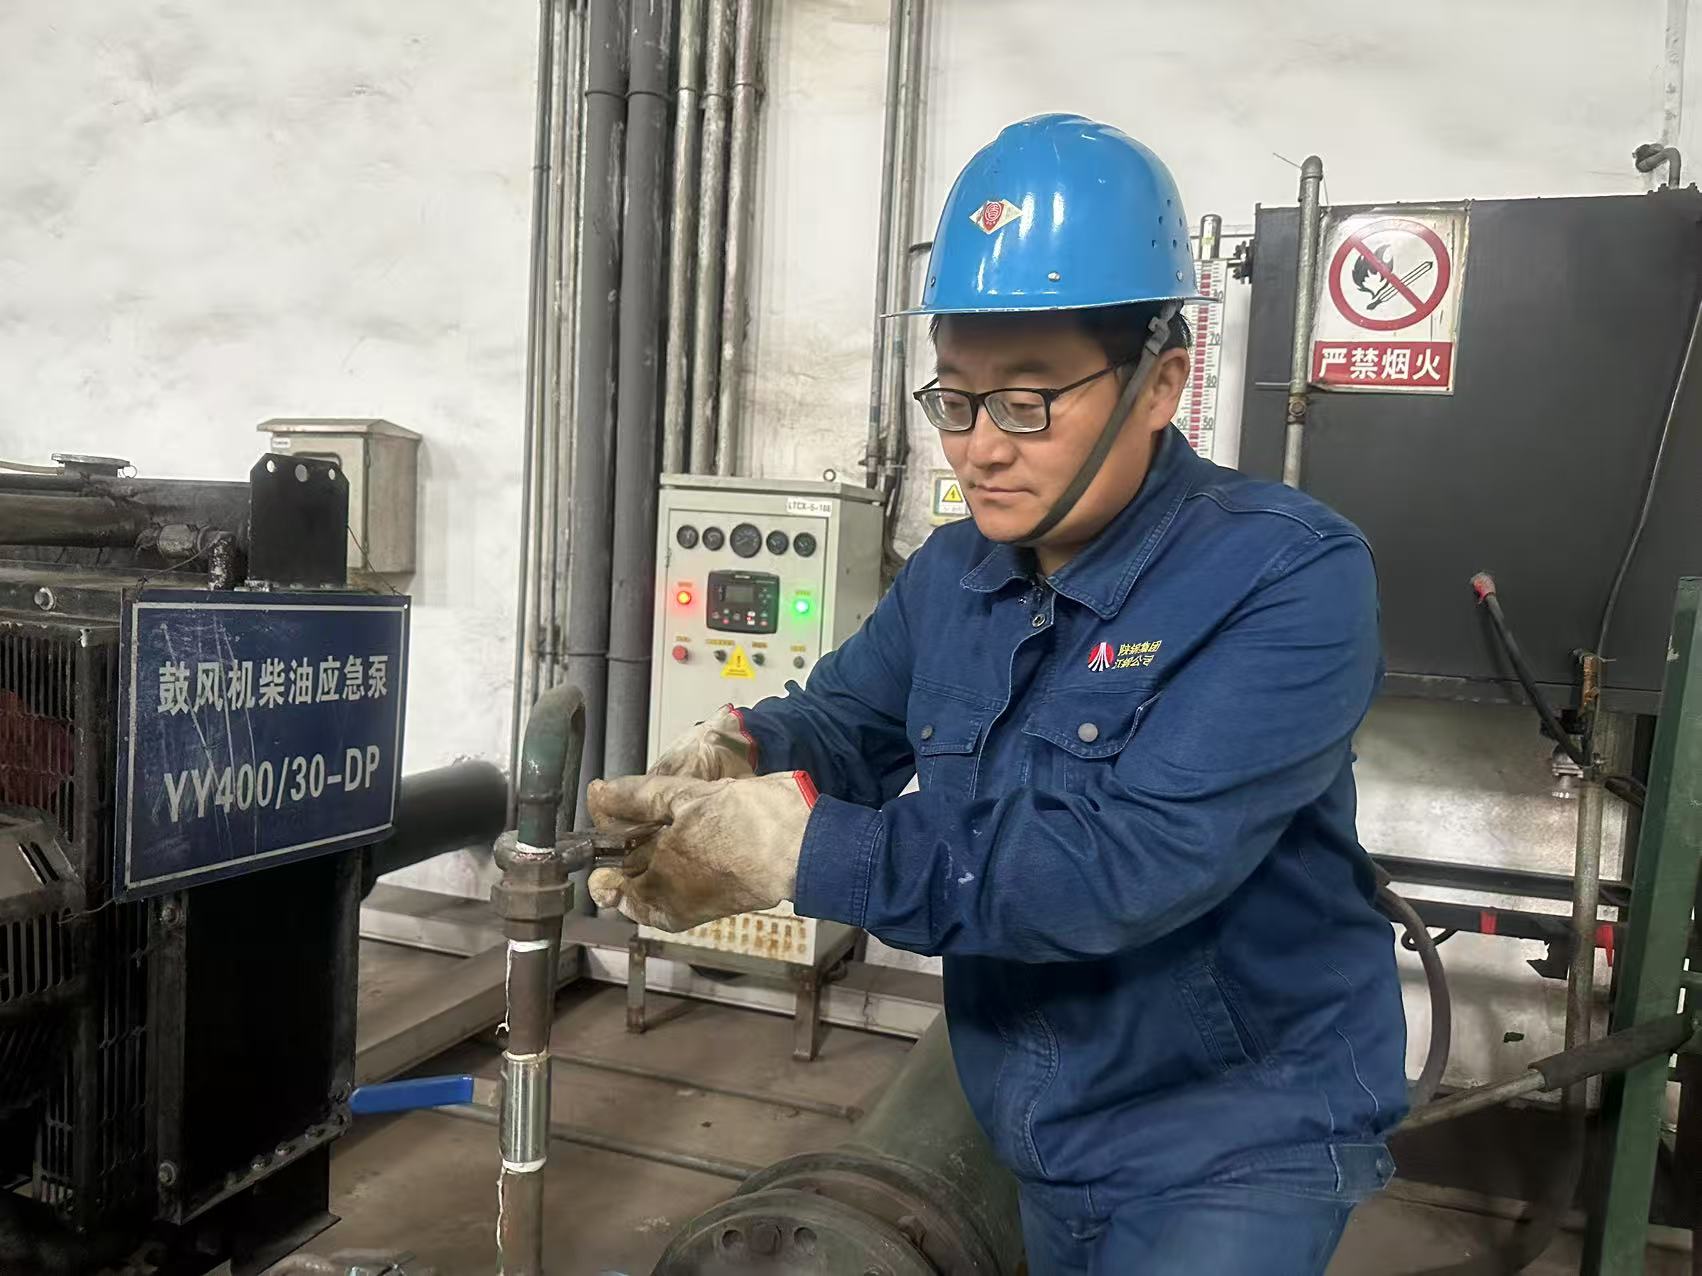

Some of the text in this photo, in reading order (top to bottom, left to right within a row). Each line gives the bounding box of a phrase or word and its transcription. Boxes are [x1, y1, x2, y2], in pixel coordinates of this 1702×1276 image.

[1319, 347, 1440, 381] 严禁烟火
[158, 655, 389, 716] 鼓风机柴油应急泵
[164, 745, 380, 823] YY400/30-DP
